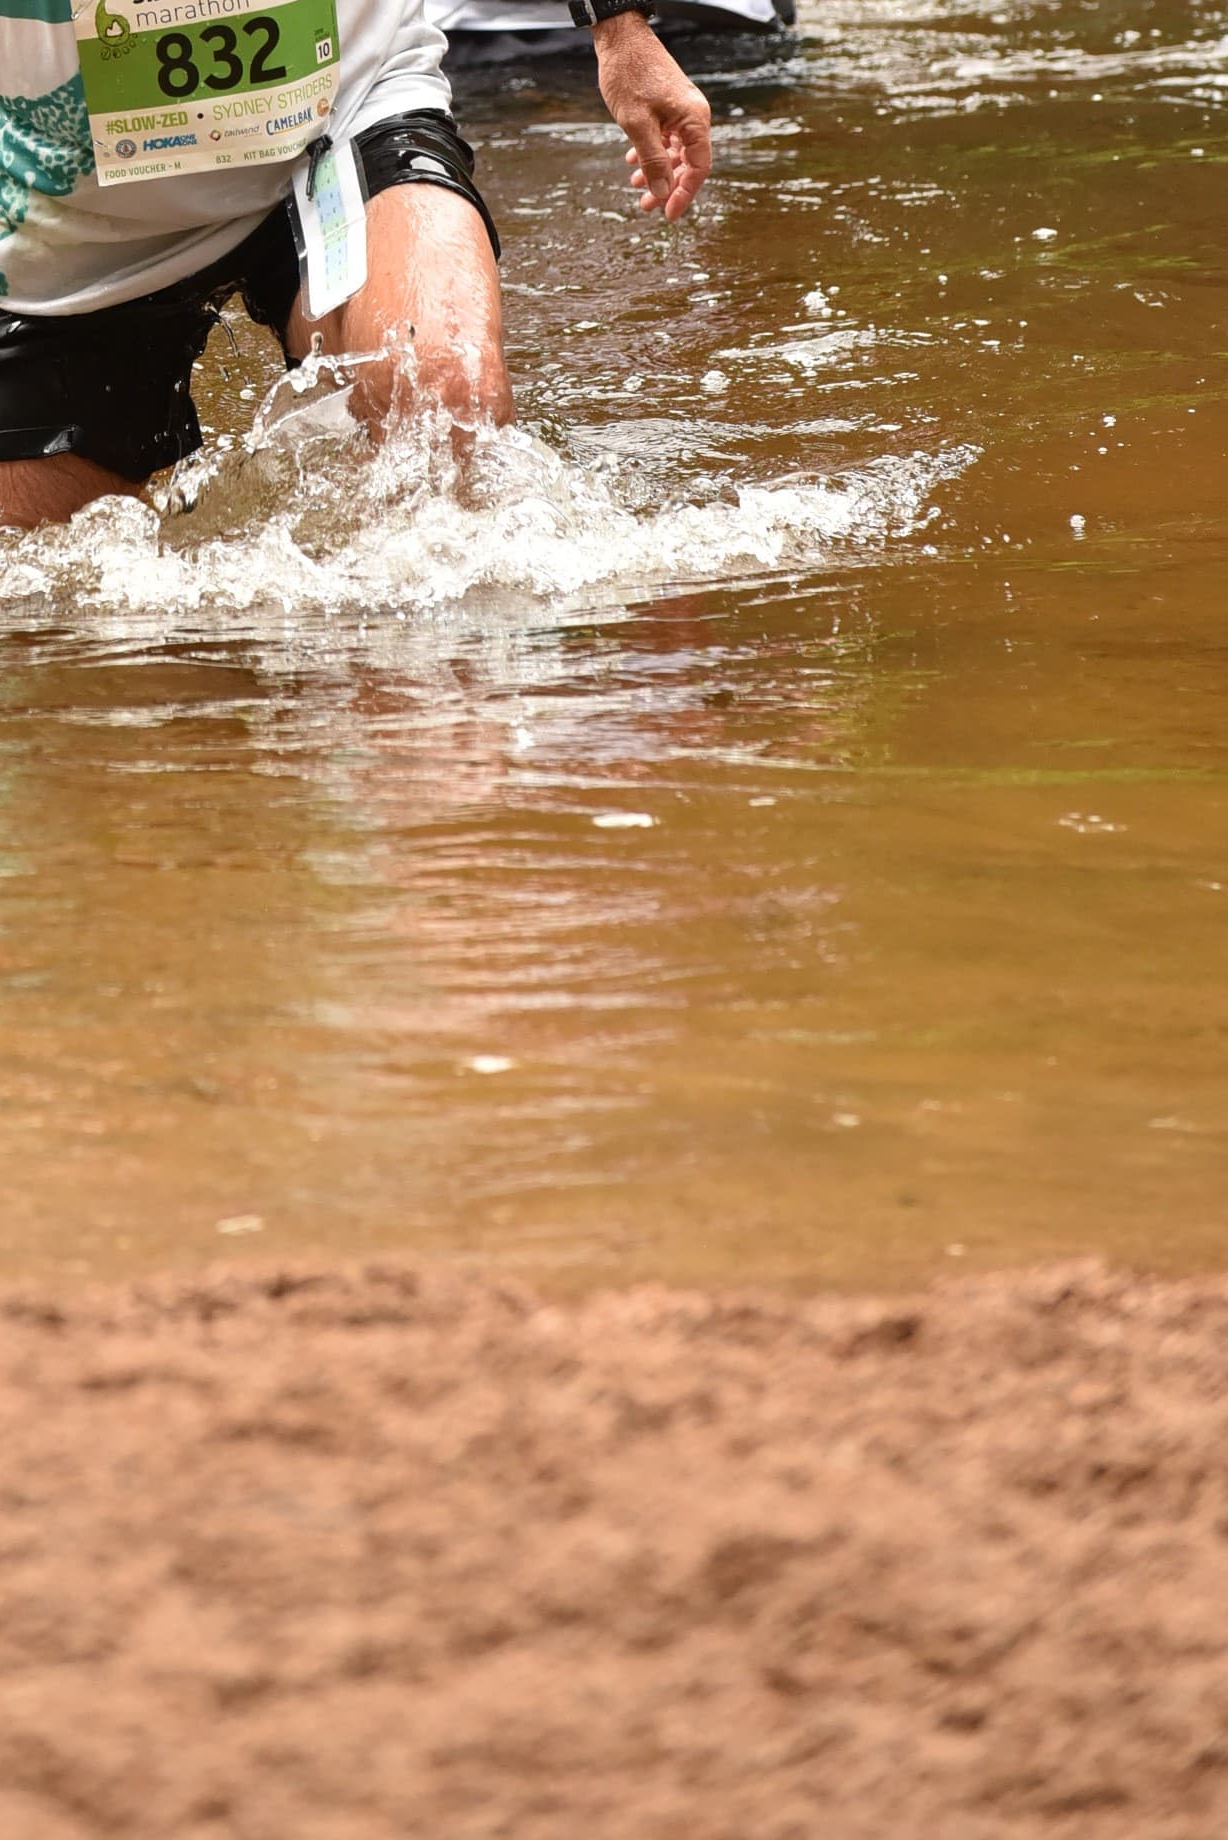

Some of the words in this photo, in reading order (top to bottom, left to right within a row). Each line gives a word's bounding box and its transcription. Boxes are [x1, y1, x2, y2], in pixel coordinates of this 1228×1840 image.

[156, 16, 287, 98] 832
[318, 42, 330, 60] 10
[105, 111, 189, 136] #SLOW-ZED
[212, 95, 273, 121] SYDNEY
[277, 73, 332, 110] STRIDERS
[265, 106, 313, 136] CAMELBAK
[143, 135, 181, 152] HOKA
[216, 154, 232, 164] 832
[243, 150, 257, 161] KIT
[259, 147, 276, 159] BAG
[105, 168, 126, 180] FOOD
[129, 162, 166, 176] VOUCHER
